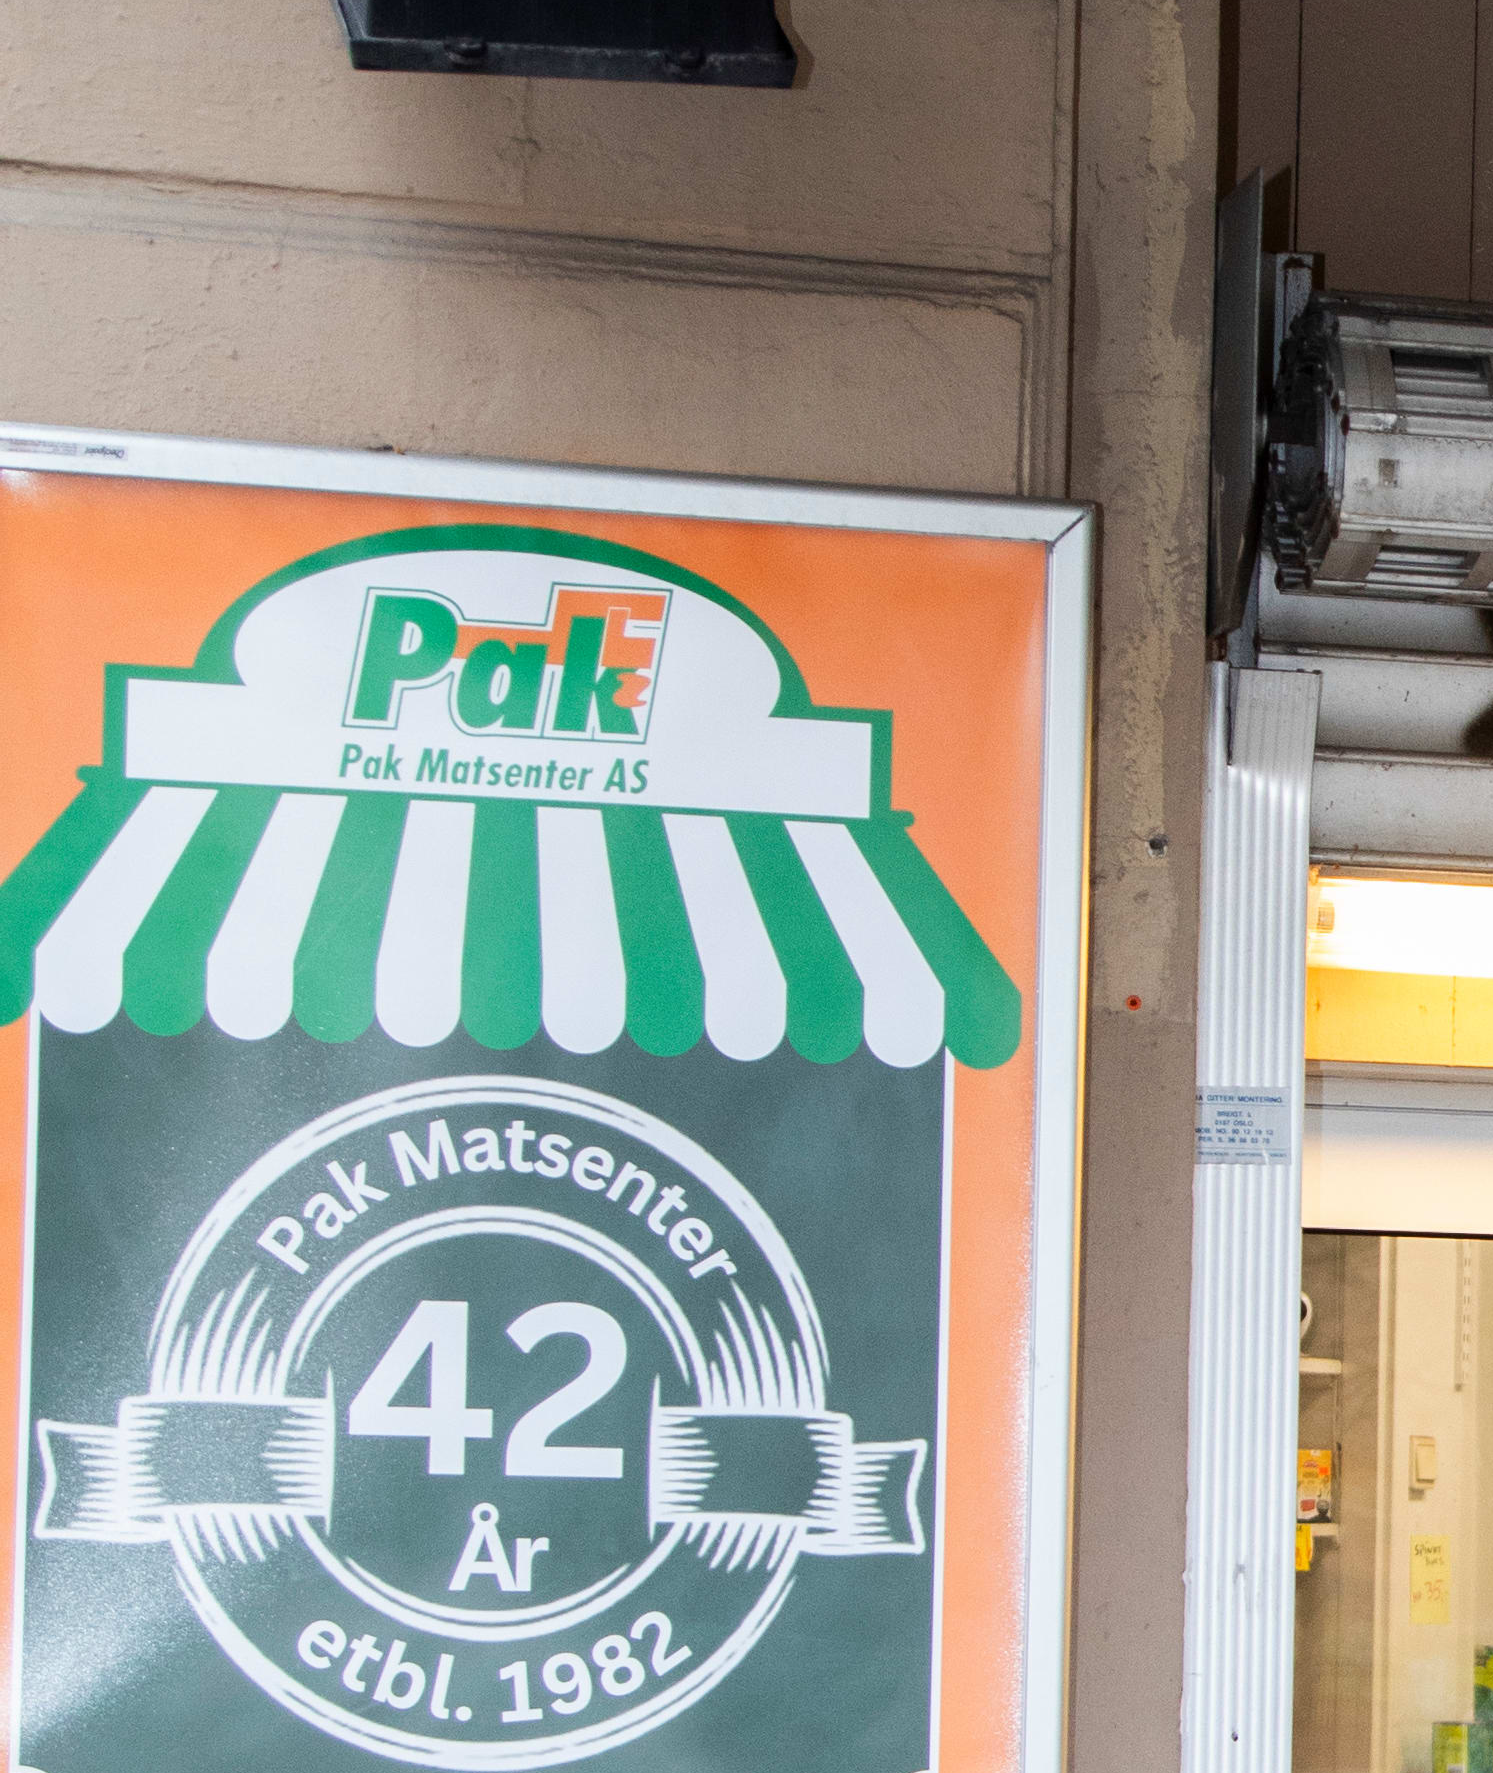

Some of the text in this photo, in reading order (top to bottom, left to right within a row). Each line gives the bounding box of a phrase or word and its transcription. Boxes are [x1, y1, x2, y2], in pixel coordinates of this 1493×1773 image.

[346, 586, 668, 741] Pak
[339, 744, 649, 794] Pak Matsenter AS
[258, 1117, 737, 1285] Pak Matsenter
[348, 1300, 626, 1478] 42
[448, 1503, 548, 1591] År
[296, 1610, 691, 1723] etbl. 1982
